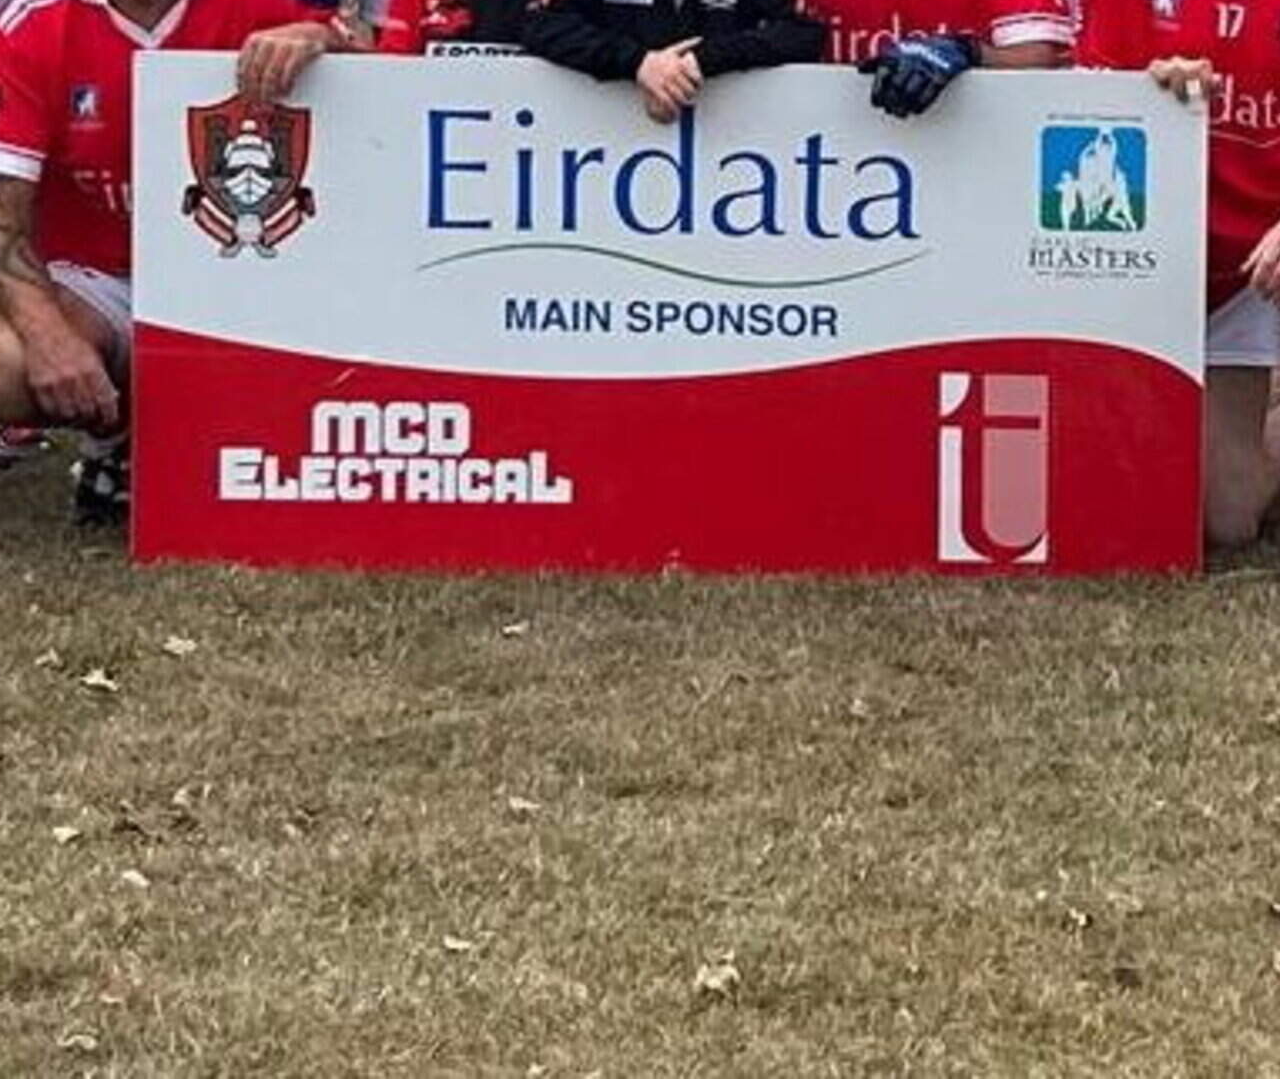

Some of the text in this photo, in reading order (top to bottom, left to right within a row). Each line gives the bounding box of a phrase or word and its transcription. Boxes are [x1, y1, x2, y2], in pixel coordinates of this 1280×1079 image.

[1217, 3, 1245, 38] 17
[426, 105, 921, 240] Eirdata
[504, 298, 839, 337] MAIN SPONSOR
[311, 400, 471, 456] MCD
